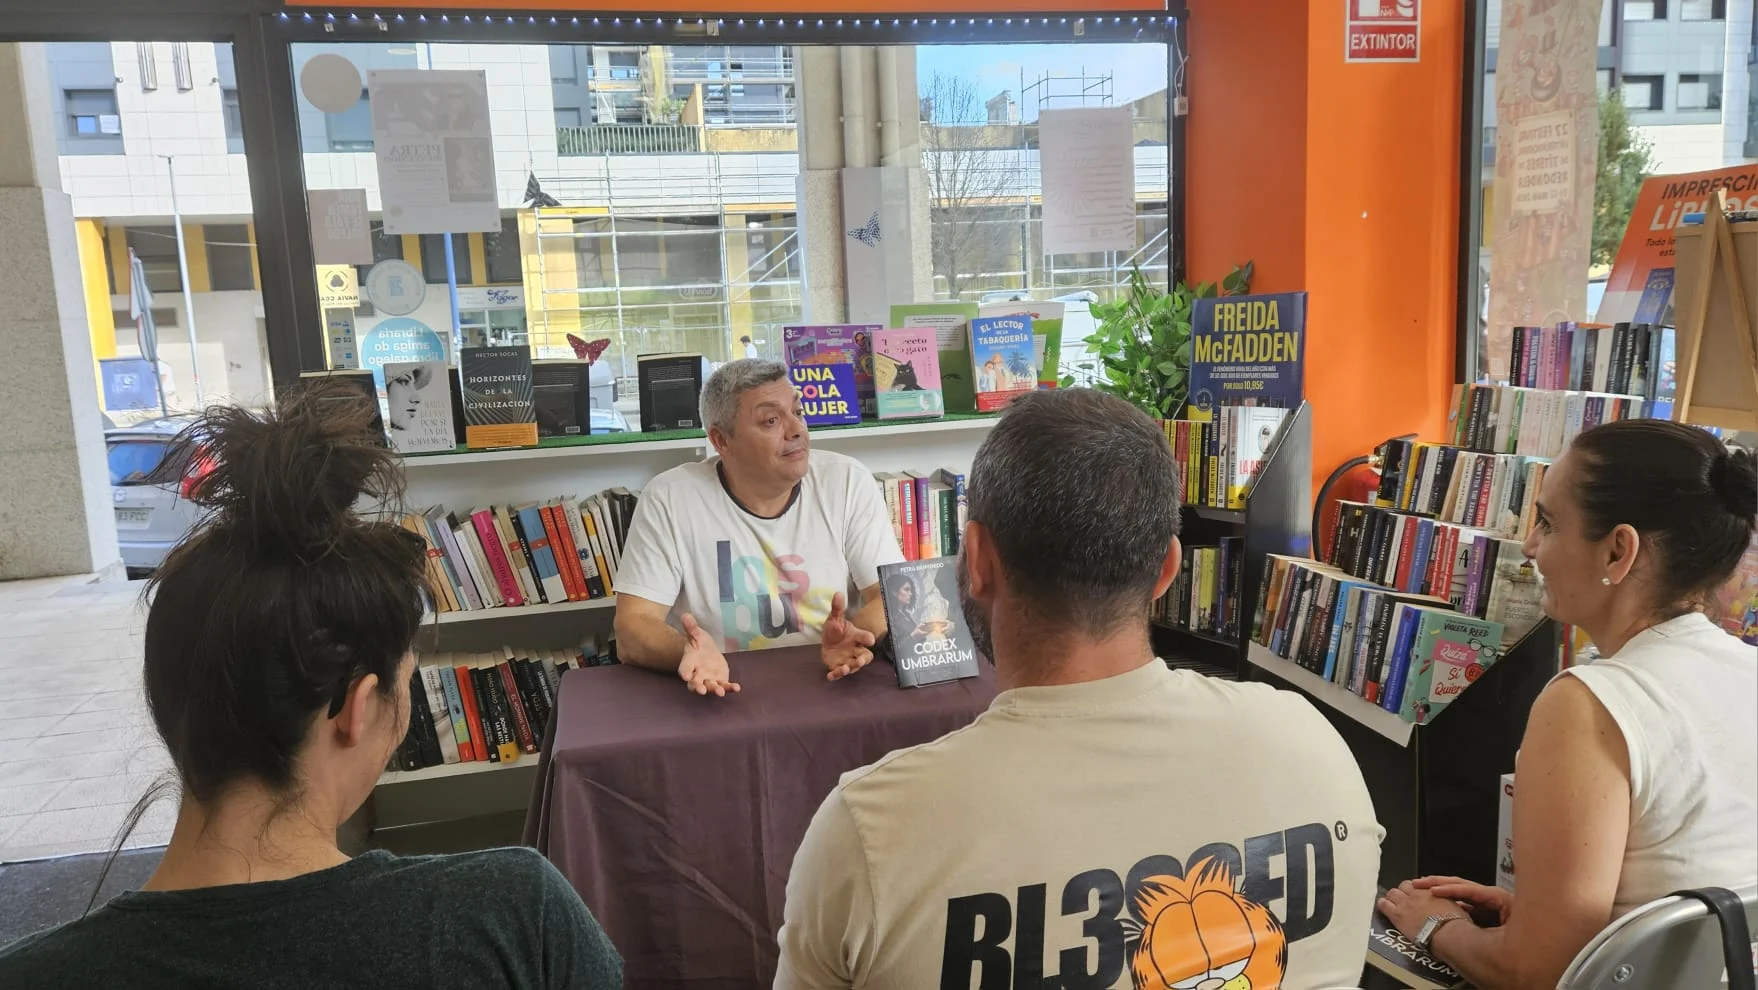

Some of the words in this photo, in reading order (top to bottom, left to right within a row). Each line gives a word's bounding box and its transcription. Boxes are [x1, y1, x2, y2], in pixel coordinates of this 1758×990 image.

[1351, 33, 1416, 50] EXTINTOR
[1213, 300, 1280, 333] FREIDA
[785, 329, 793, 339] 3
[980, 324, 992, 333] EL
[993, 320, 1024, 330] LECTOR
[977, 333, 1029, 345] TABAQUERÍA
[1194, 331, 1299, 364] McFADDEN
[469, 374, 527, 384] HORIZONTES
[793, 367, 836, 382] UNA
[1444, 623, 1467, 633] VIOLETA
[1468, 627, 1489, 637] REED
[914, 638, 957, 655] CODEX
[901, 649, 973, 670] UMBRARUM
[1434, 681, 1466, 696] Quier
[1369, 928, 1459, 978] MBRARUM
